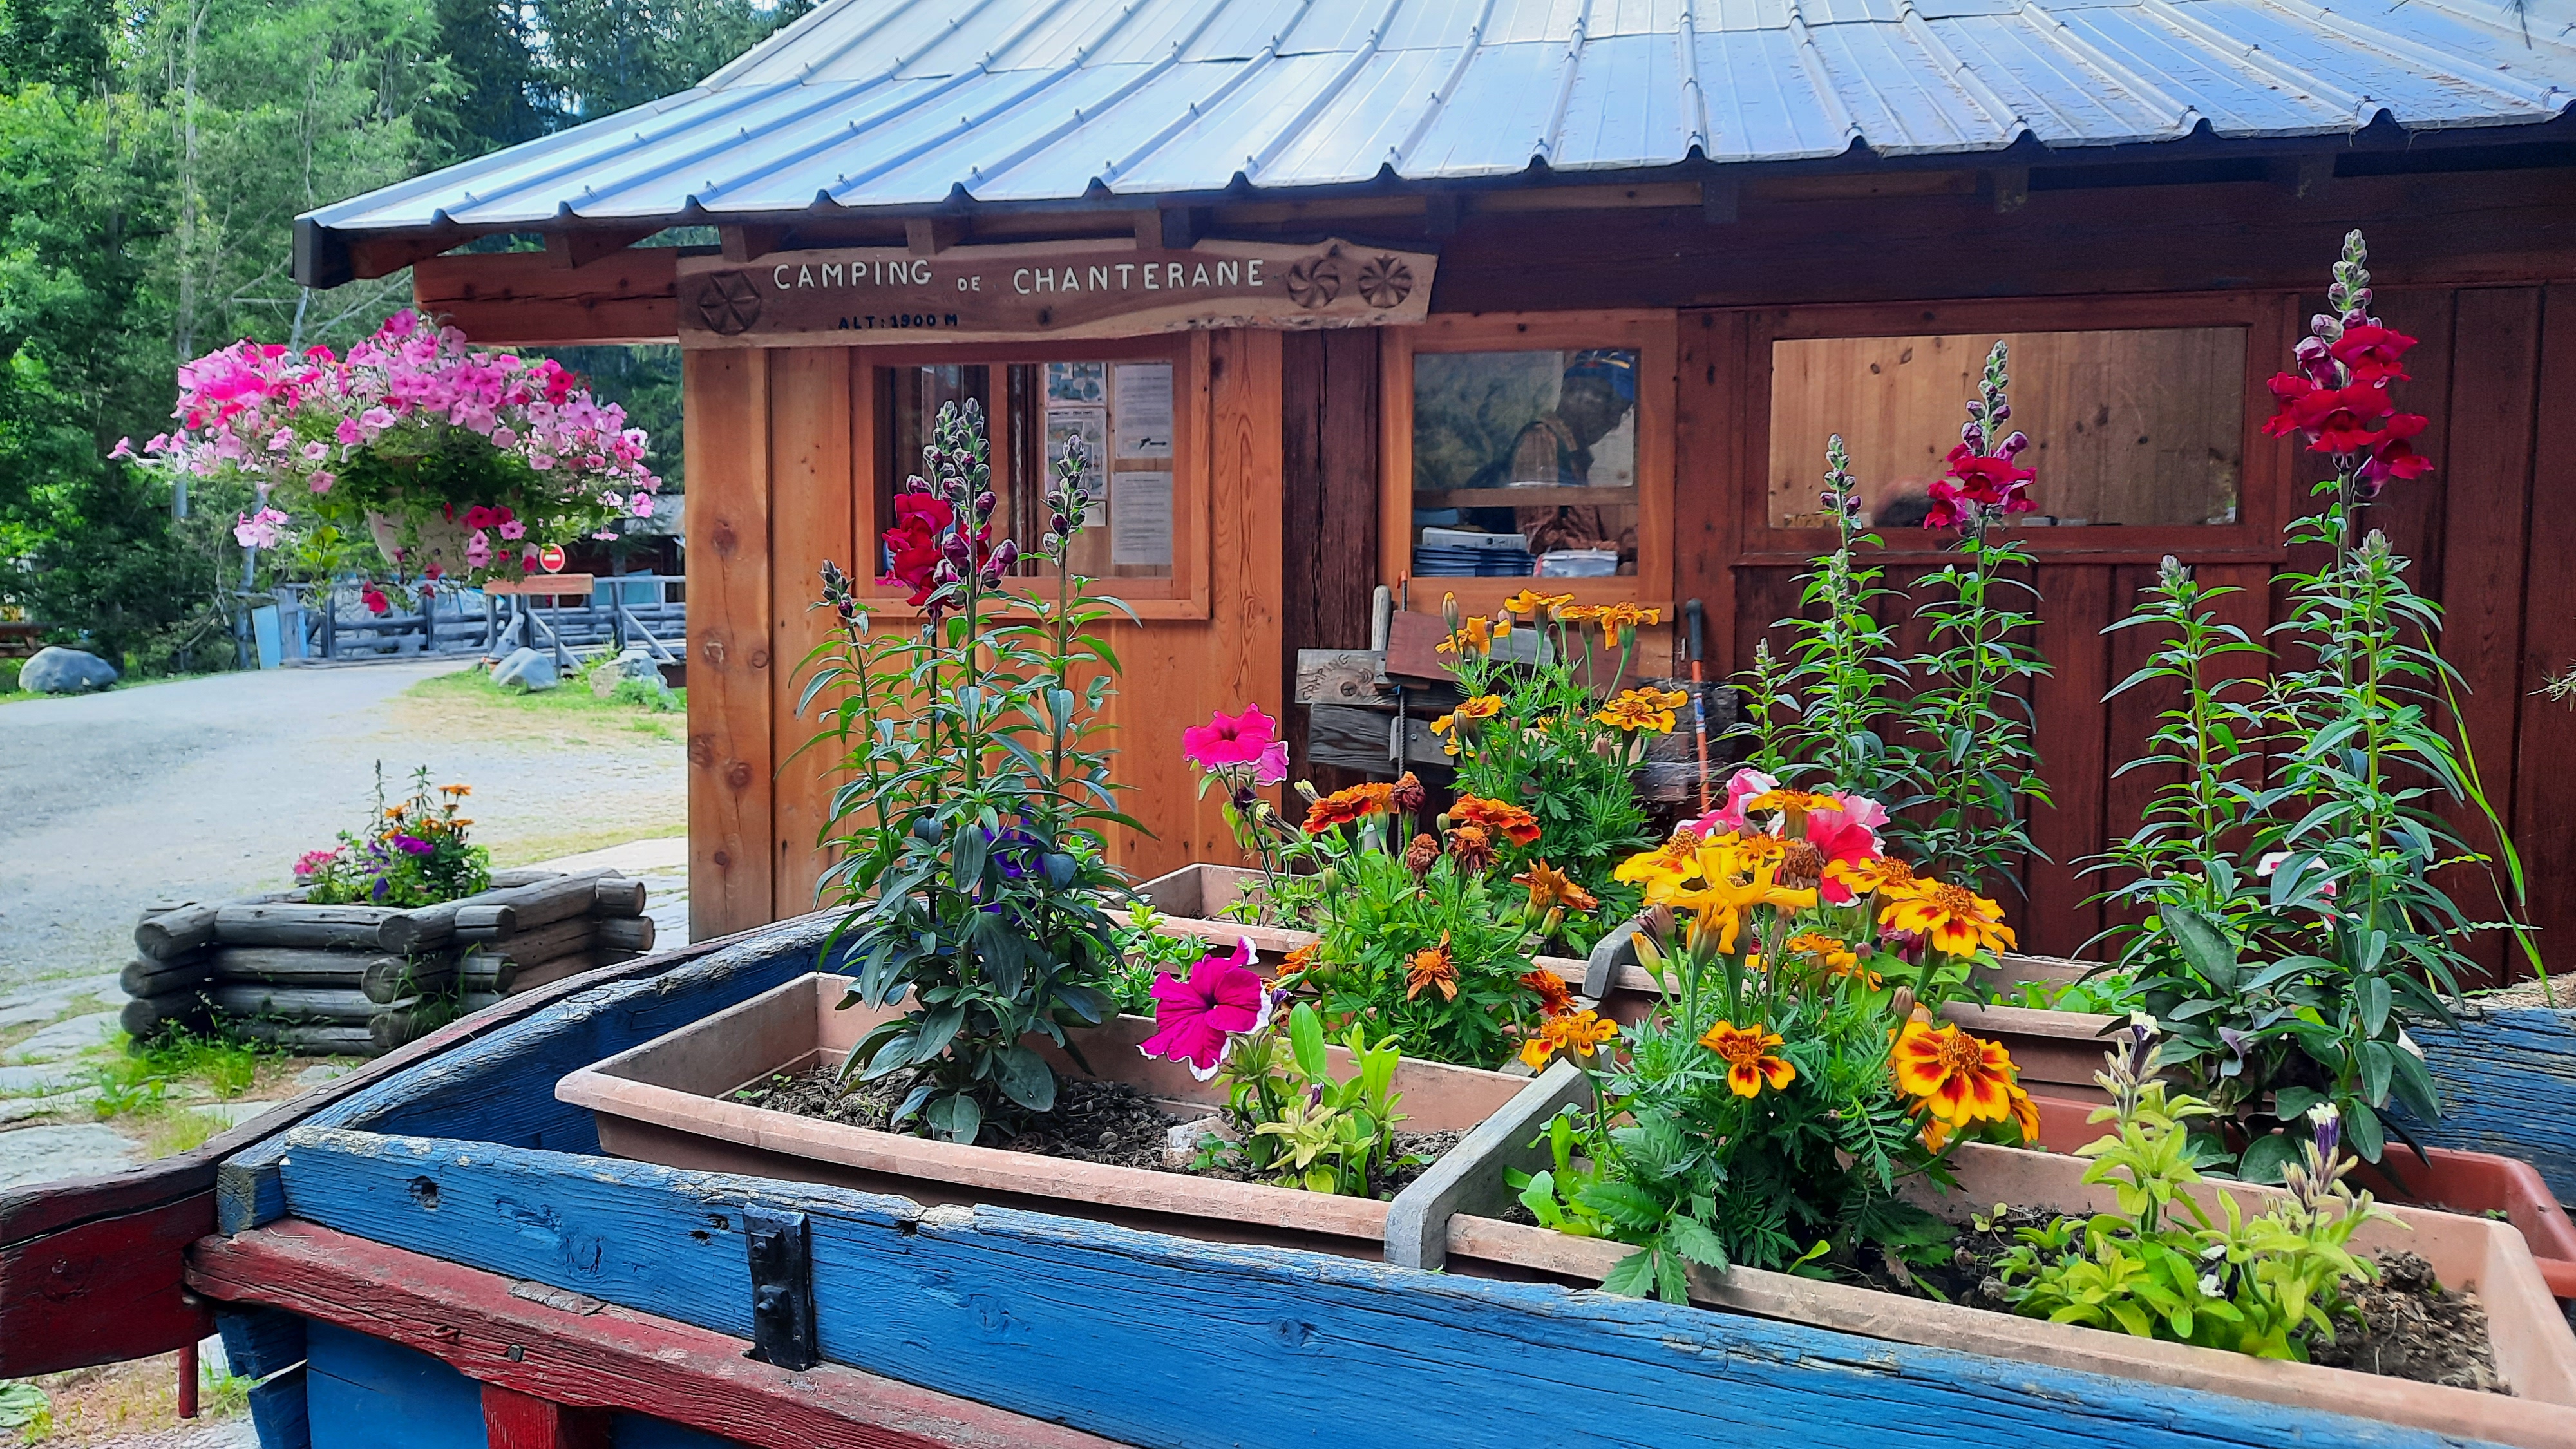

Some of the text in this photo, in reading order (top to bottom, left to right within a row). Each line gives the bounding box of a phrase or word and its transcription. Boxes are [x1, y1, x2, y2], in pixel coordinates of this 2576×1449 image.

[773, 259, 1264, 294] CAMPING DE CHANTERANE
[944, 314, 959, 327] M
